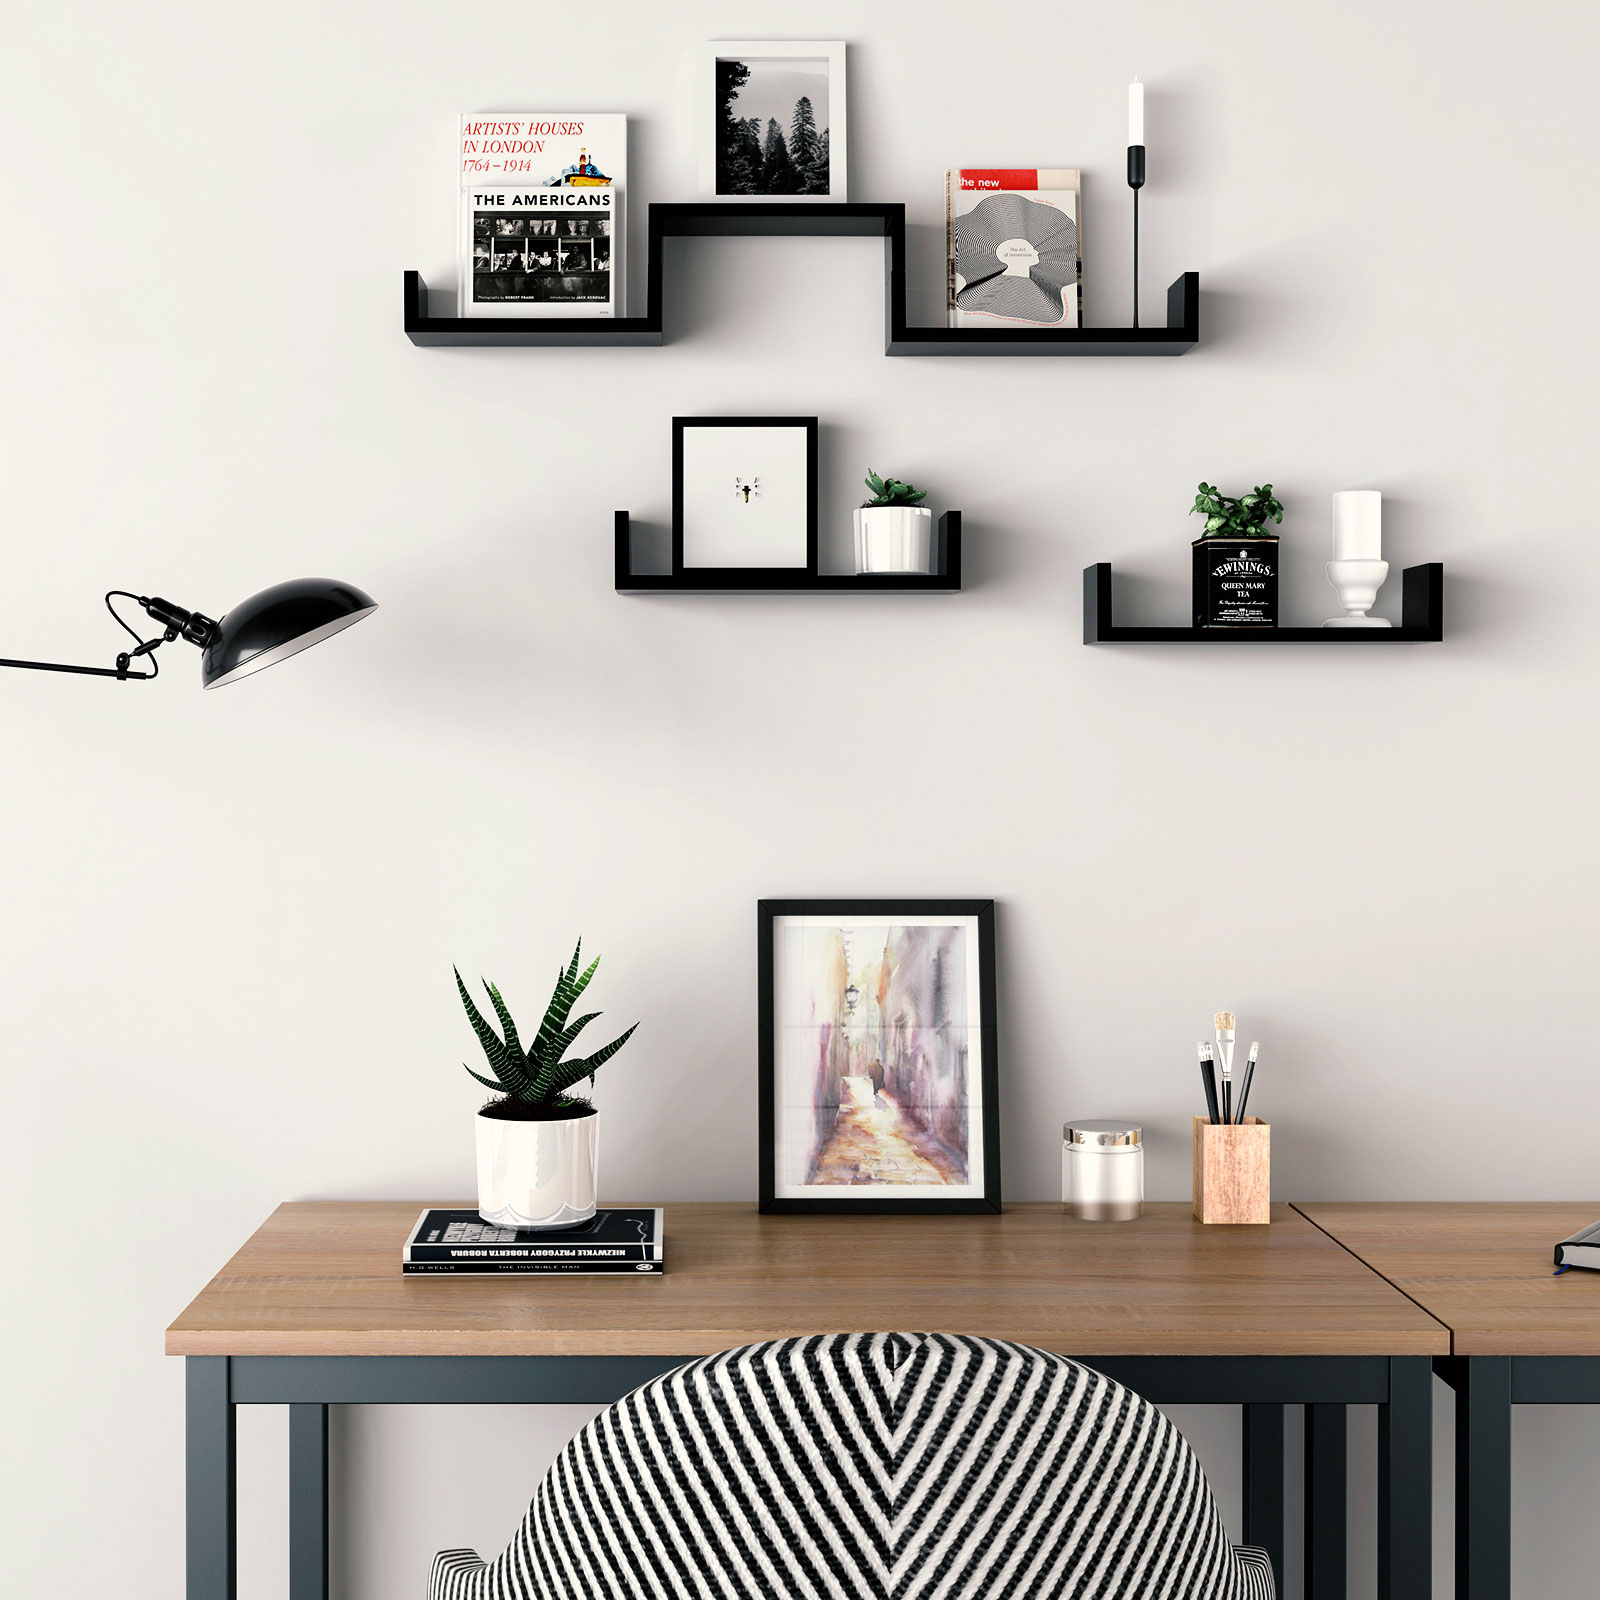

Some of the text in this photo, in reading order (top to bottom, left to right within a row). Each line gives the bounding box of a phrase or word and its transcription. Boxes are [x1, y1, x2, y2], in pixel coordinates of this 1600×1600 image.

[528, 122, 584, 136] HOUSES
[463, 140, 545, 153] IN LONDON
[474, 194, 611, 206] THE AMERICANS
[450, 1249, 488, 1257] ROBURA
[488, 1249, 529, 1257] ROBERTA
[530, 1249, 576, 1257] PRZYGODY
